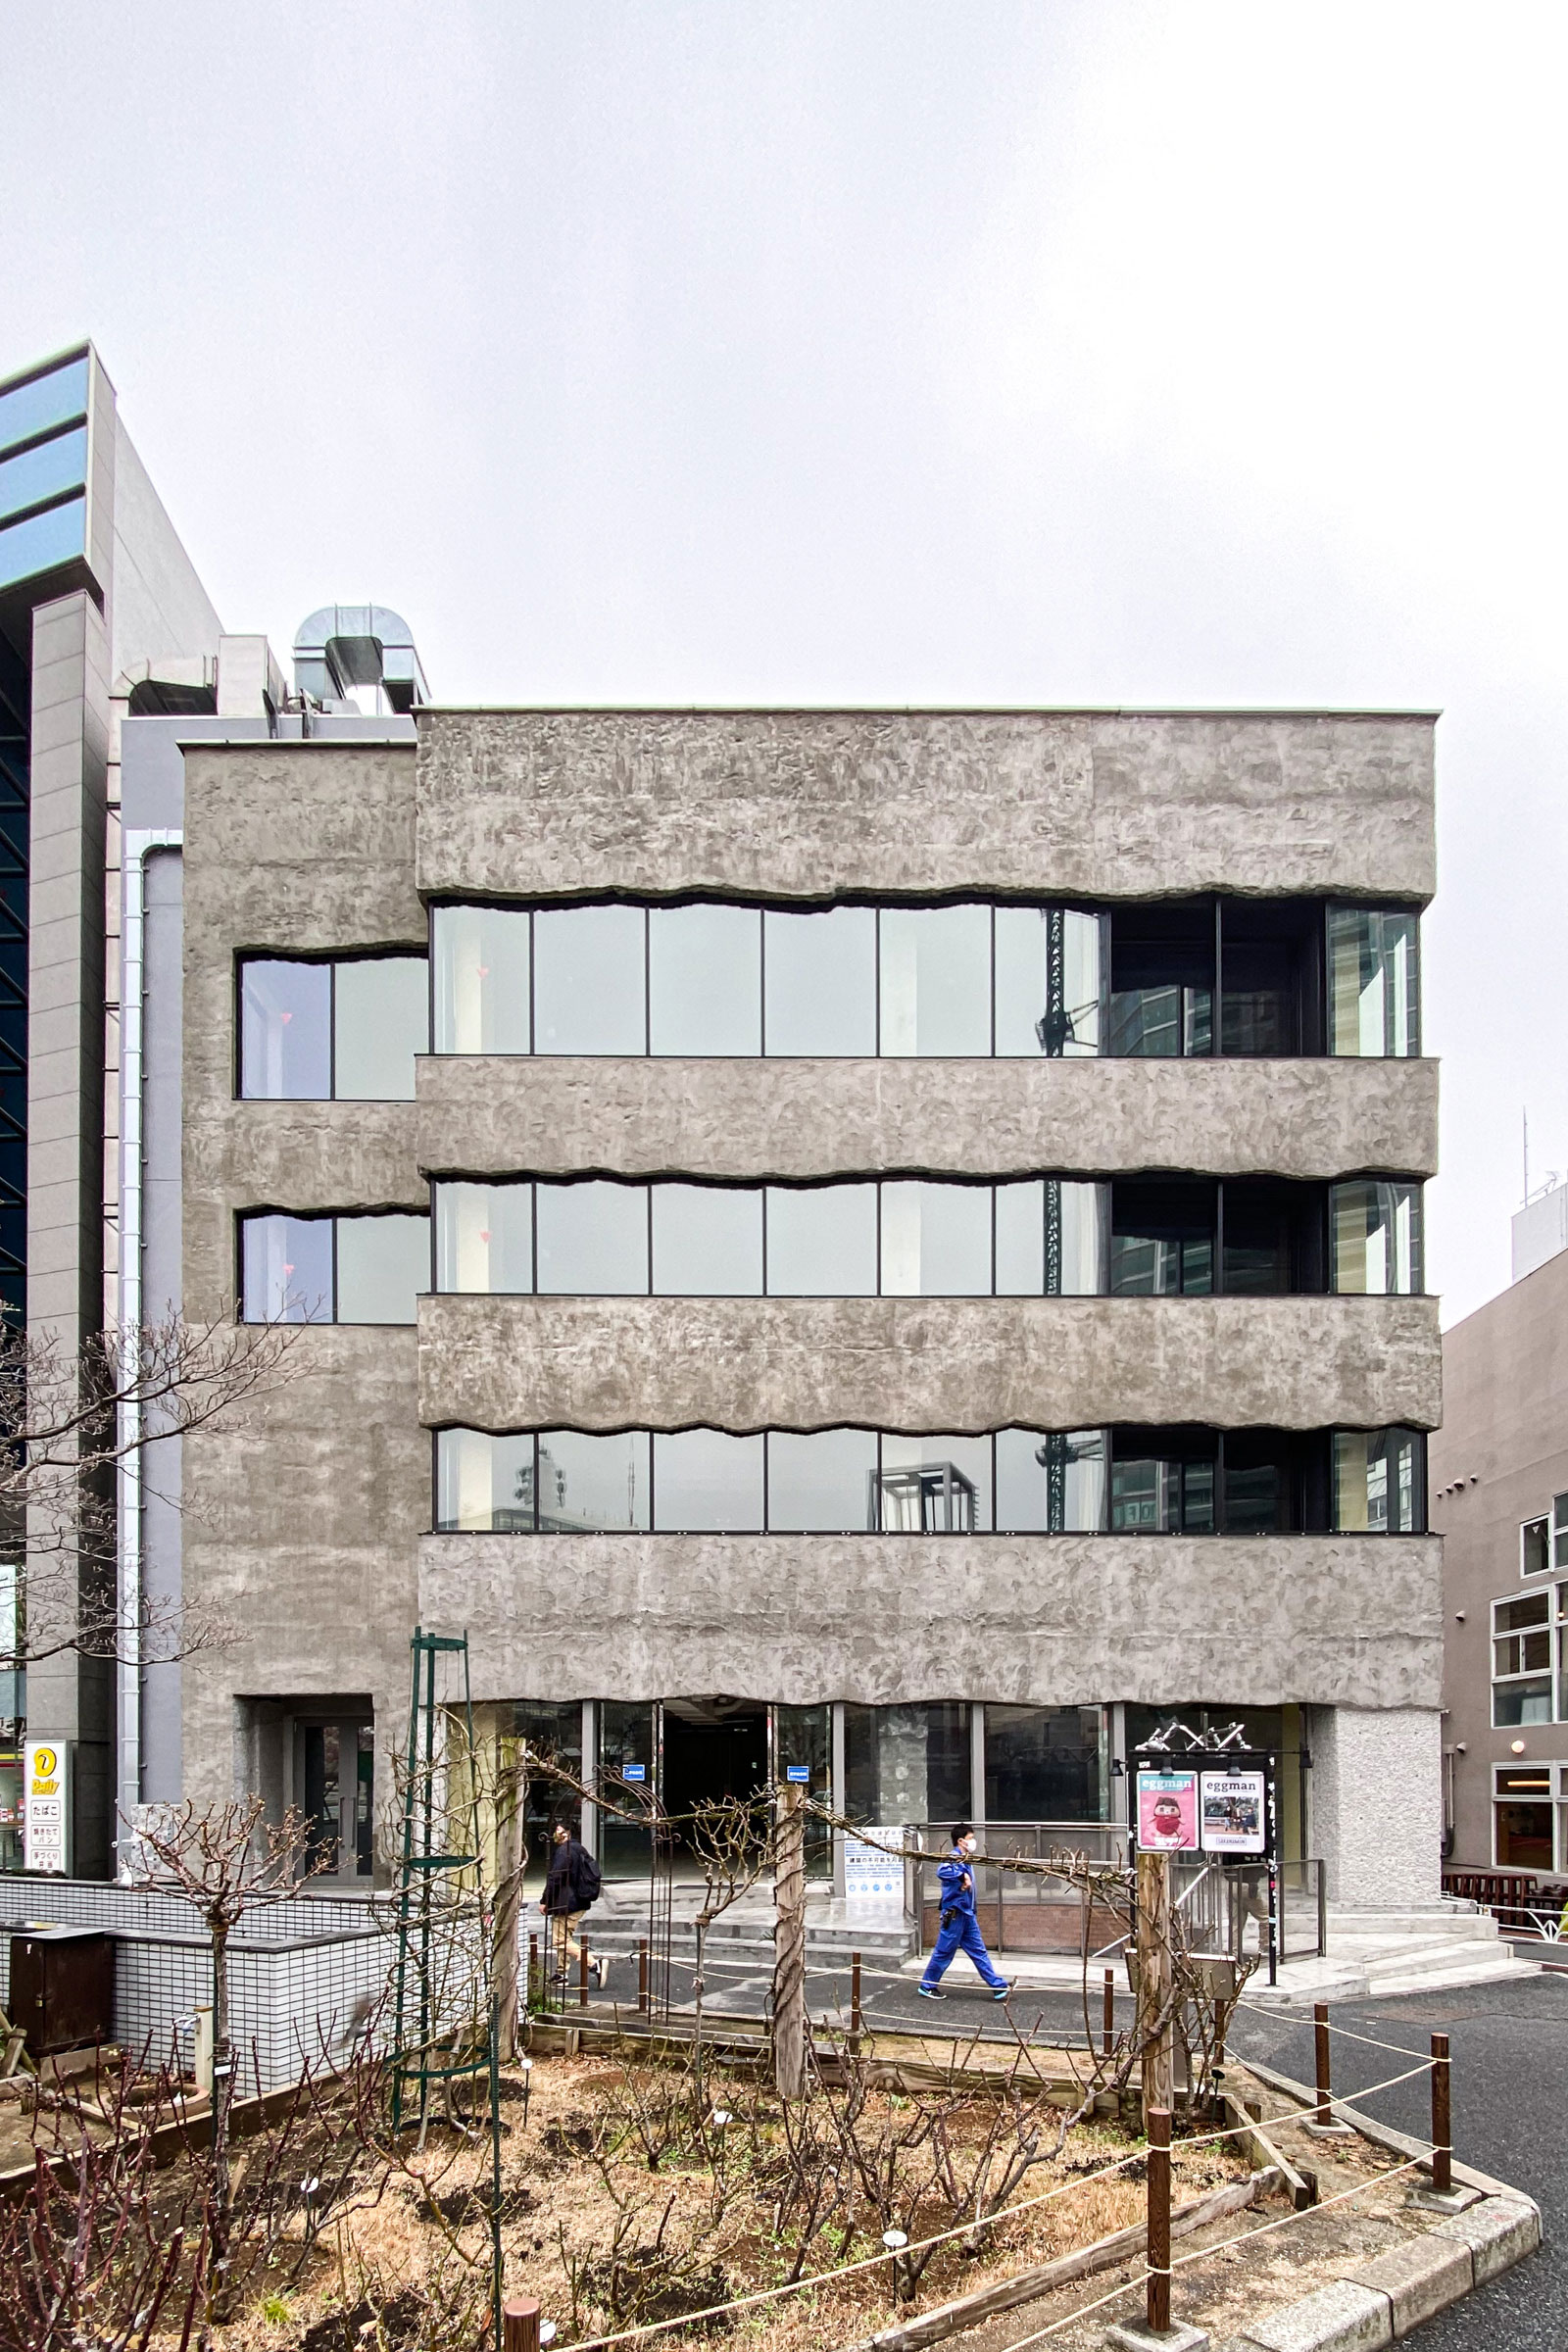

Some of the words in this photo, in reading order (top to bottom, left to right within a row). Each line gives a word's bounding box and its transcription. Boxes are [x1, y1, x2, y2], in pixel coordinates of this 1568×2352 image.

[32, 1779, 59, 1794] Daily
[1142, 1779, 1192, 1791] eggman
[1206, 1782, 1256, 1792] eggman
[33, 1806, 58, 1815] たばこ
